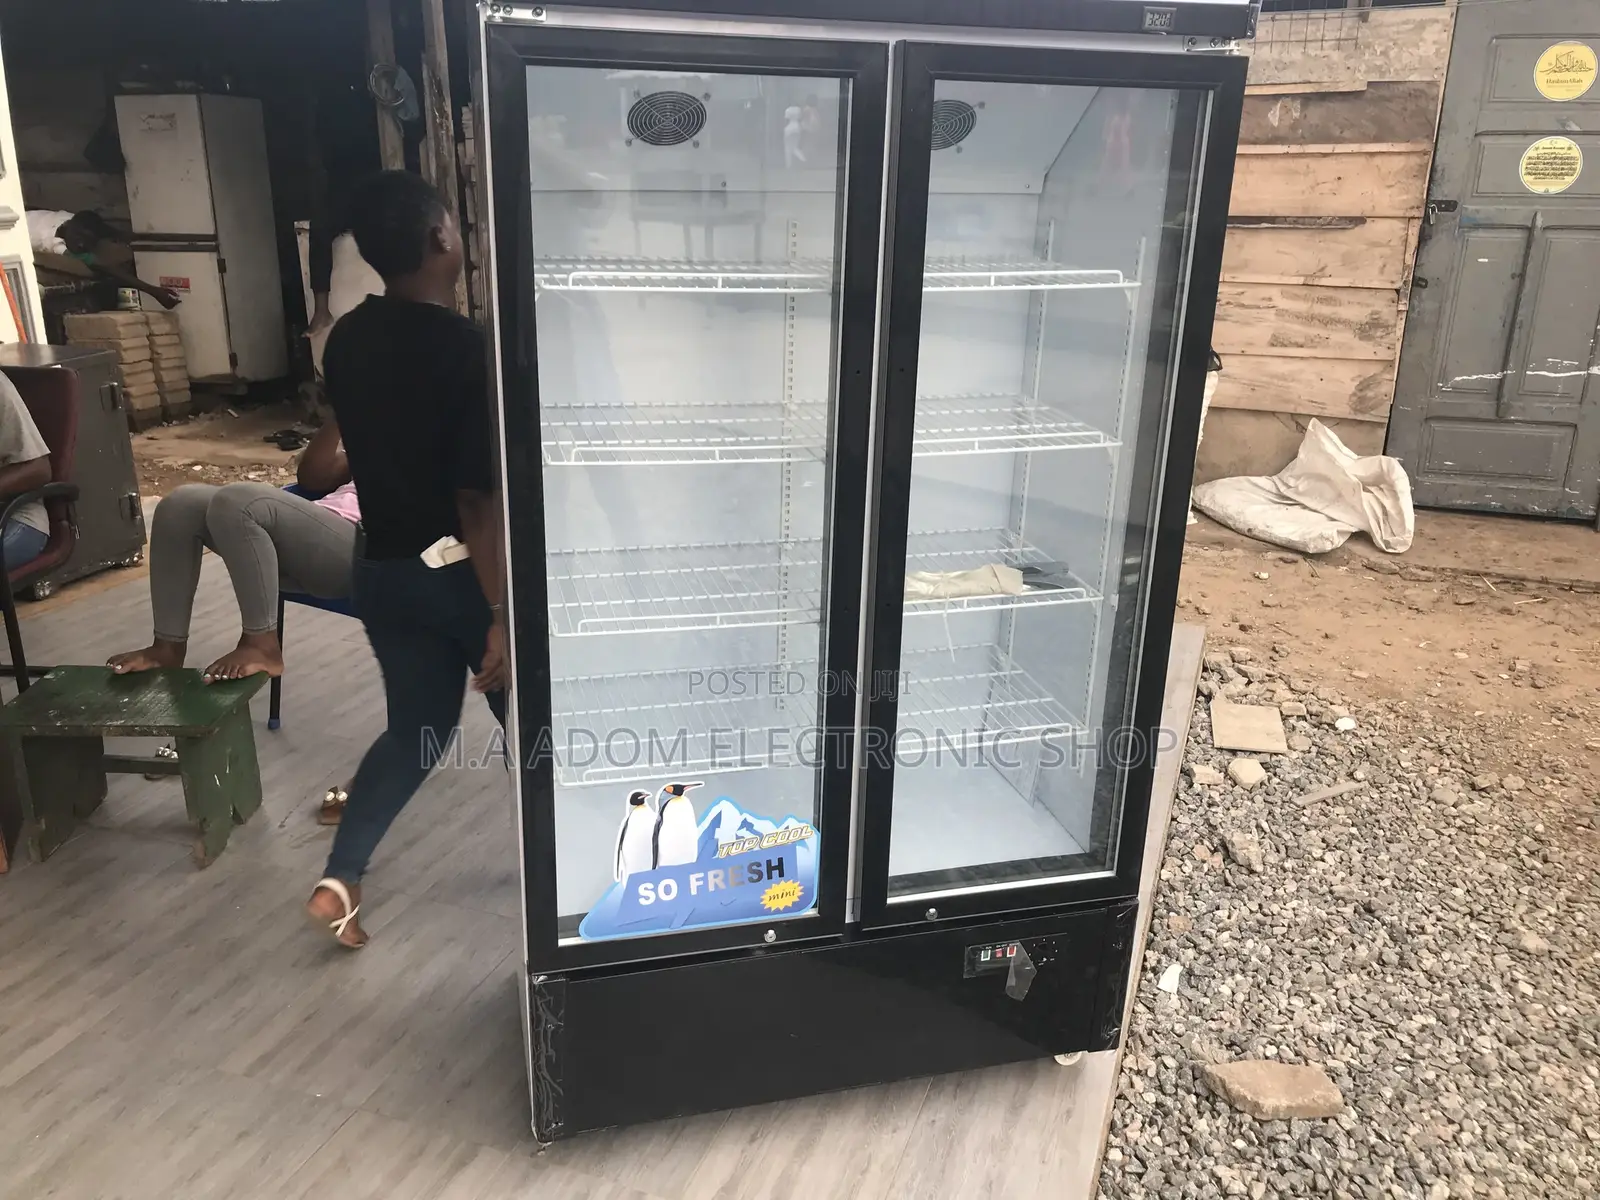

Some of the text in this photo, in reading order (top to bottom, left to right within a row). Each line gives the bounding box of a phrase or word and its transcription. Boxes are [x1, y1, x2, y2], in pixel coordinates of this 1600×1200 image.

[718, 824, 814, 859] TOP COOL
[637, 856, 785, 906] SO FRESH
[767, 887, 797, 902] mini
